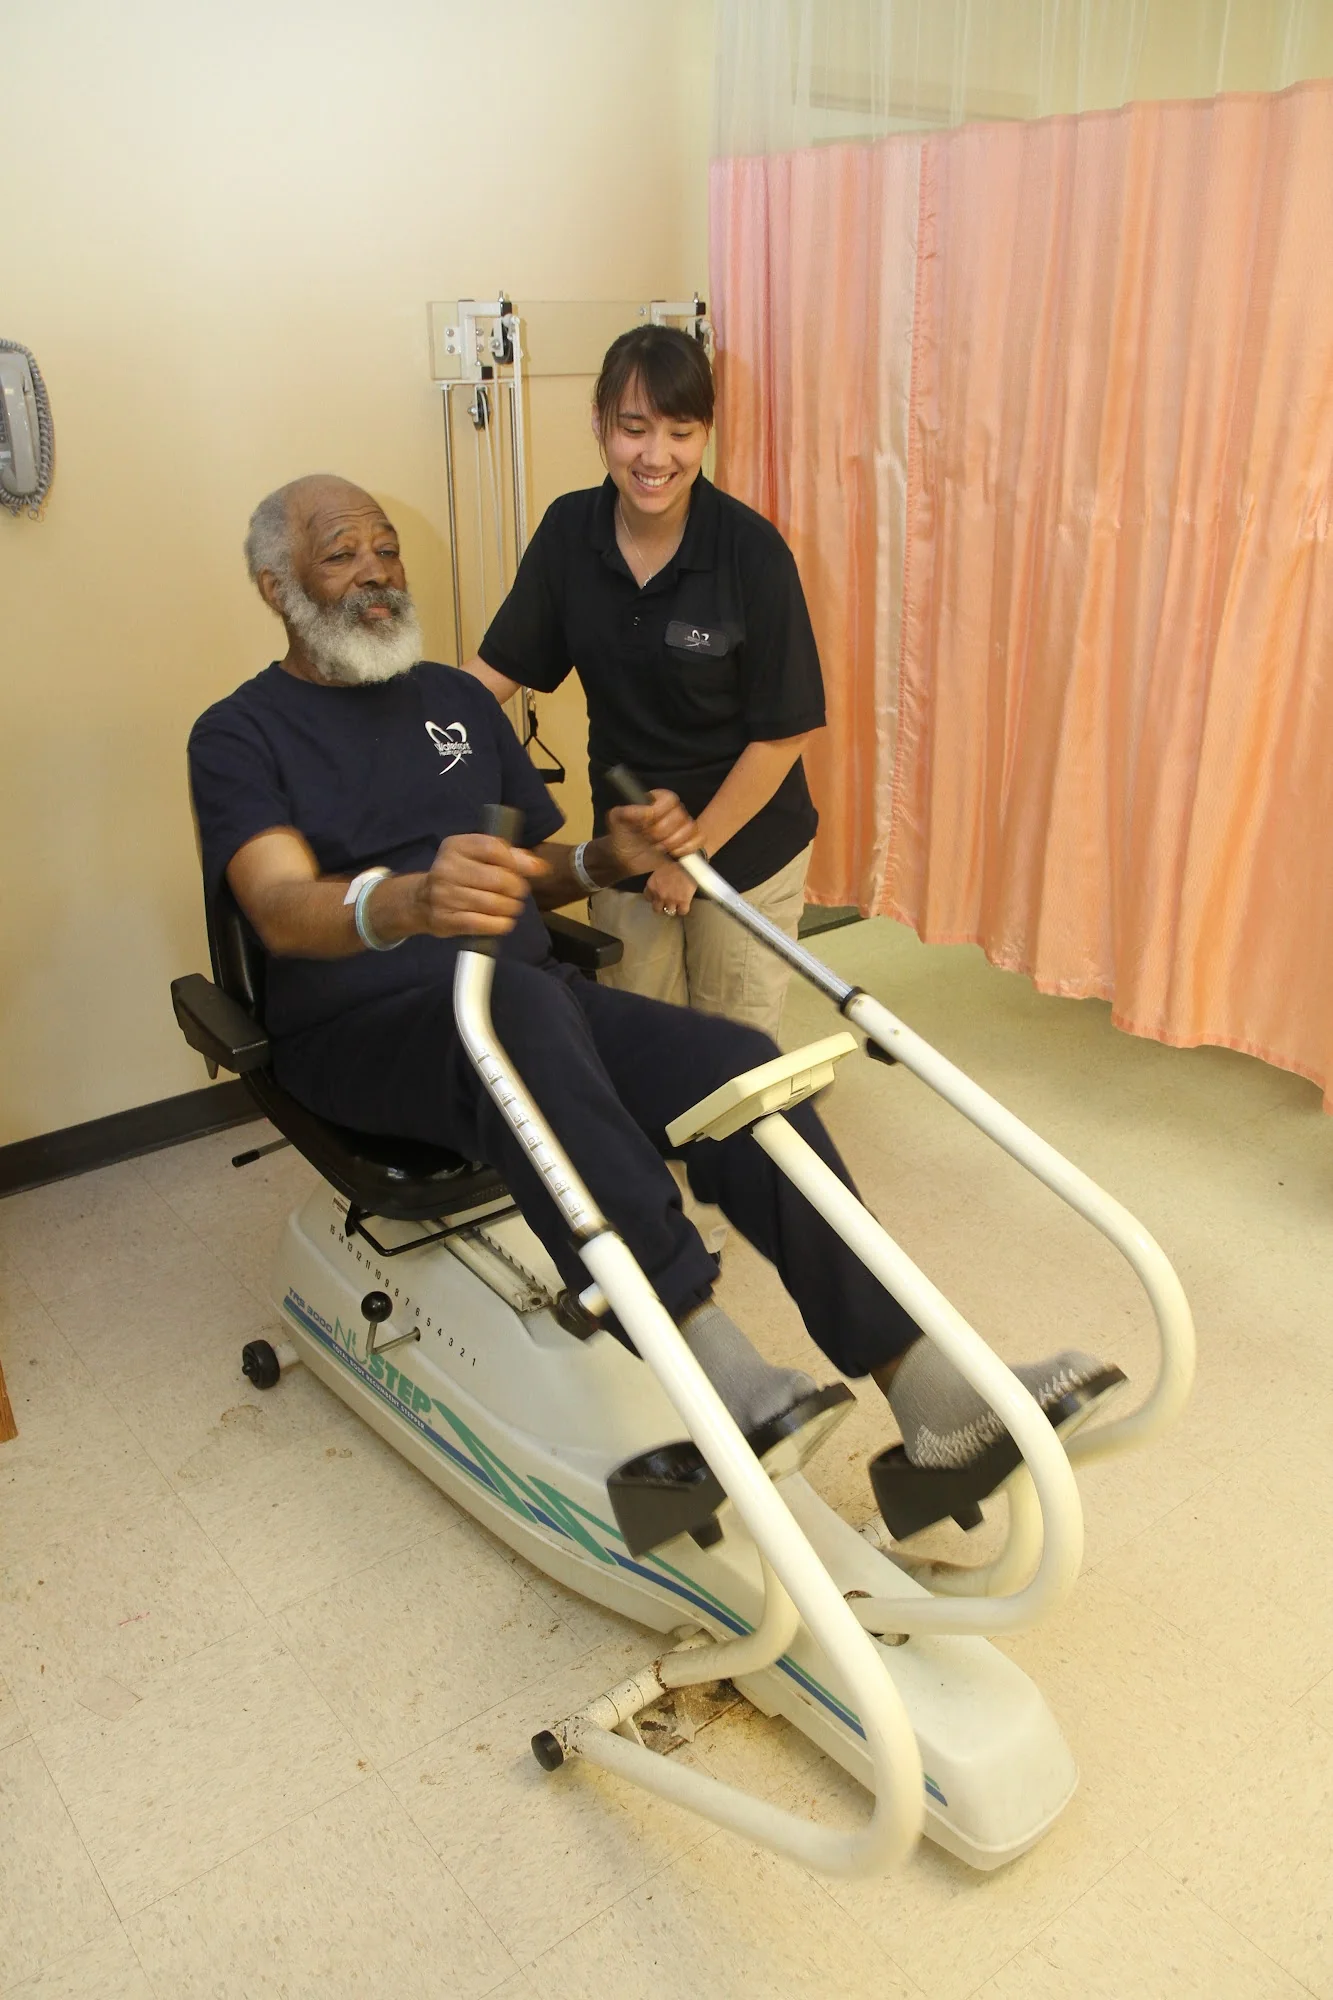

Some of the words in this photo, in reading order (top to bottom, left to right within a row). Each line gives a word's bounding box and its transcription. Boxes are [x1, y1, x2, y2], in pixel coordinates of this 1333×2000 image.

[488, 1069, 499, 1079] 3
[502, 1092, 512, 1100] 4
[514, 1113, 525, 1123] 5
[528, 1136, 539, 1145] 6
[555, 1180, 566, 1190] 8
[569, 1203, 580, 1212] 9
[288, 1286, 305, 1308] TRS
[306, 1305, 332, 1333] 3000
[330, 1224, 336, 1235] 15
[339, 1233, 344, 1243] 14
[347, 1242, 353, 1252] 13
[356, 1251, 362, 1261] 12
[366, 1260, 371, 1270] 11
[375, 1269, 381, 1280] 10
[385, 1278, 390, 1287] 9
[395, 1288, 399, 1296] 8
[405, 1298, 410, 1306] 7
[416, 1307, 420, 1316] 6
[426, 1317, 431, 1326] 5
[437, 1328, 442, 1336] 4
[449, 1338, 454, 1346] 3
[460, 1348, 465, 1357] 2
[332, 1343, 349, 1362] TOTAL
[350, 1360, 365, 1376] BODY
[366, 1374, 399, 1408] RECUMBENT
[400, 1405, 425, 1430] STEPPER
